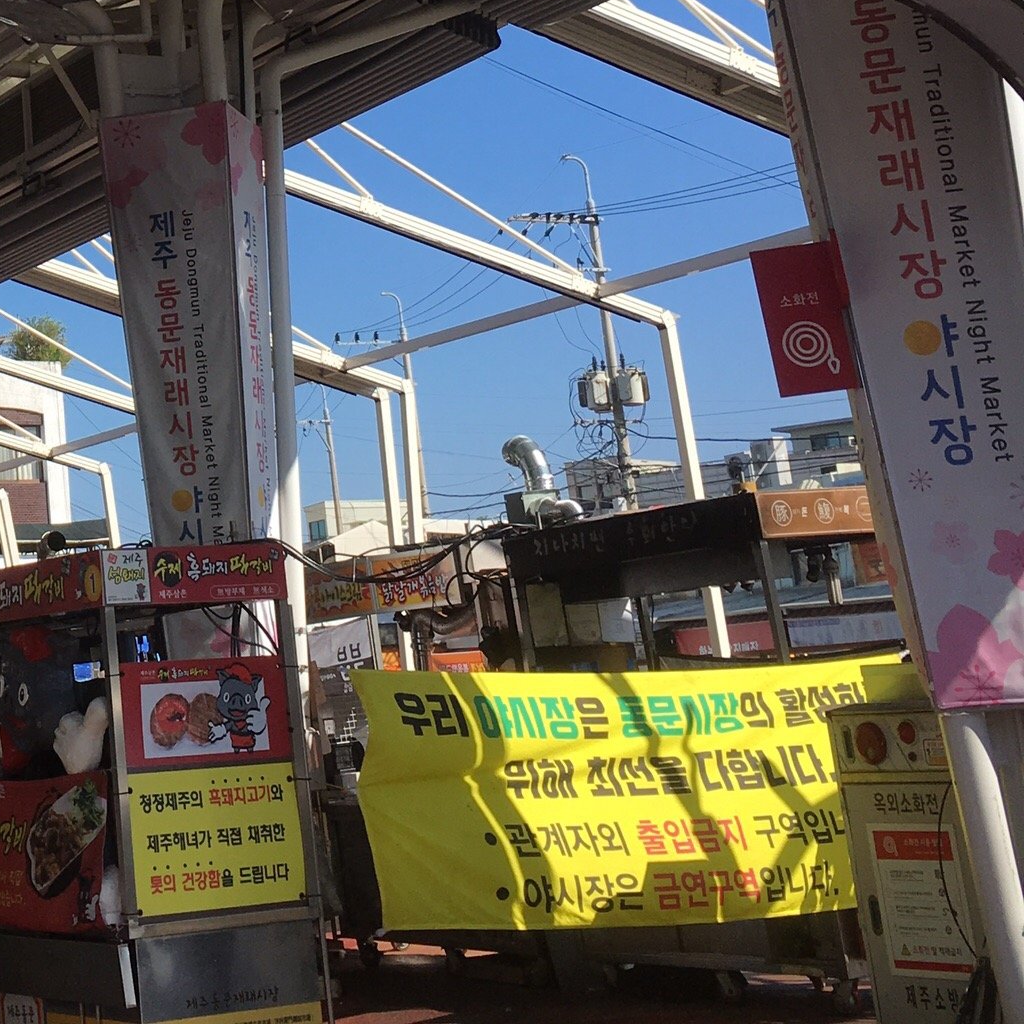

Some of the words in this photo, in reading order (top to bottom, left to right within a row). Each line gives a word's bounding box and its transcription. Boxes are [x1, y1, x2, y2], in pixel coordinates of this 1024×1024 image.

[922, 62, 964, 194] Traditional
[149, 210, 178, 269] 제주
[181, 208, 195, 241] Jeju
[948, 204, 979, 288] Market
[185, 248, 201, 317] Dongmun
[779, 291, 820, 308] 소화전
[965, 299, 996, 364] Night
[154, 278, 200, 477] 동문재래시장
[192, 323, 212, 408] Traditional
[200, 414, 220, 469] Market
[980, 376, 1014, 463] Market
[207, 476, 222, 518] Night
[122, 552, 144, 568] 제주
[154, 557, 183, 581] 수제
[186, 554, 229, 582] 흑돼지
[229, 553, 274, 575] 떡갈비
[23, 568, 66, 605] 떡갈비
[381, 573, 447, 606] 닭날개볶음밥
[393, 691, 471, 738] 우리
[472, 695, 610, 741] 야시장은
[620, 687, 775, 740] 동문시장의
[503, 756, 577, 800] 위해
[587, 753, 693, 798] 최선을
[692, 742, 837, 794] 다합니다.
[139, 789, 204, 814] 청정제주의
[208, 784, 284, 807] 흑돼지고기와
[873, 792, 941, 816] 옥외소화전
[146, 829, 212, 853] 제주해녀가
[216, 827, 243, 847] 직접
[247, 823, 286, 844] 채취한
[507, 821, 631, 860] 관계자외
[636, 814, 751, 857] 출입금지
[182, 868, 234, 892] 건강함을
[239, 863, 290, 884] 드립니다
[523, 872, 646, 913] 야시장은
[652, 860, 840, 911] 금연구역입니다.
